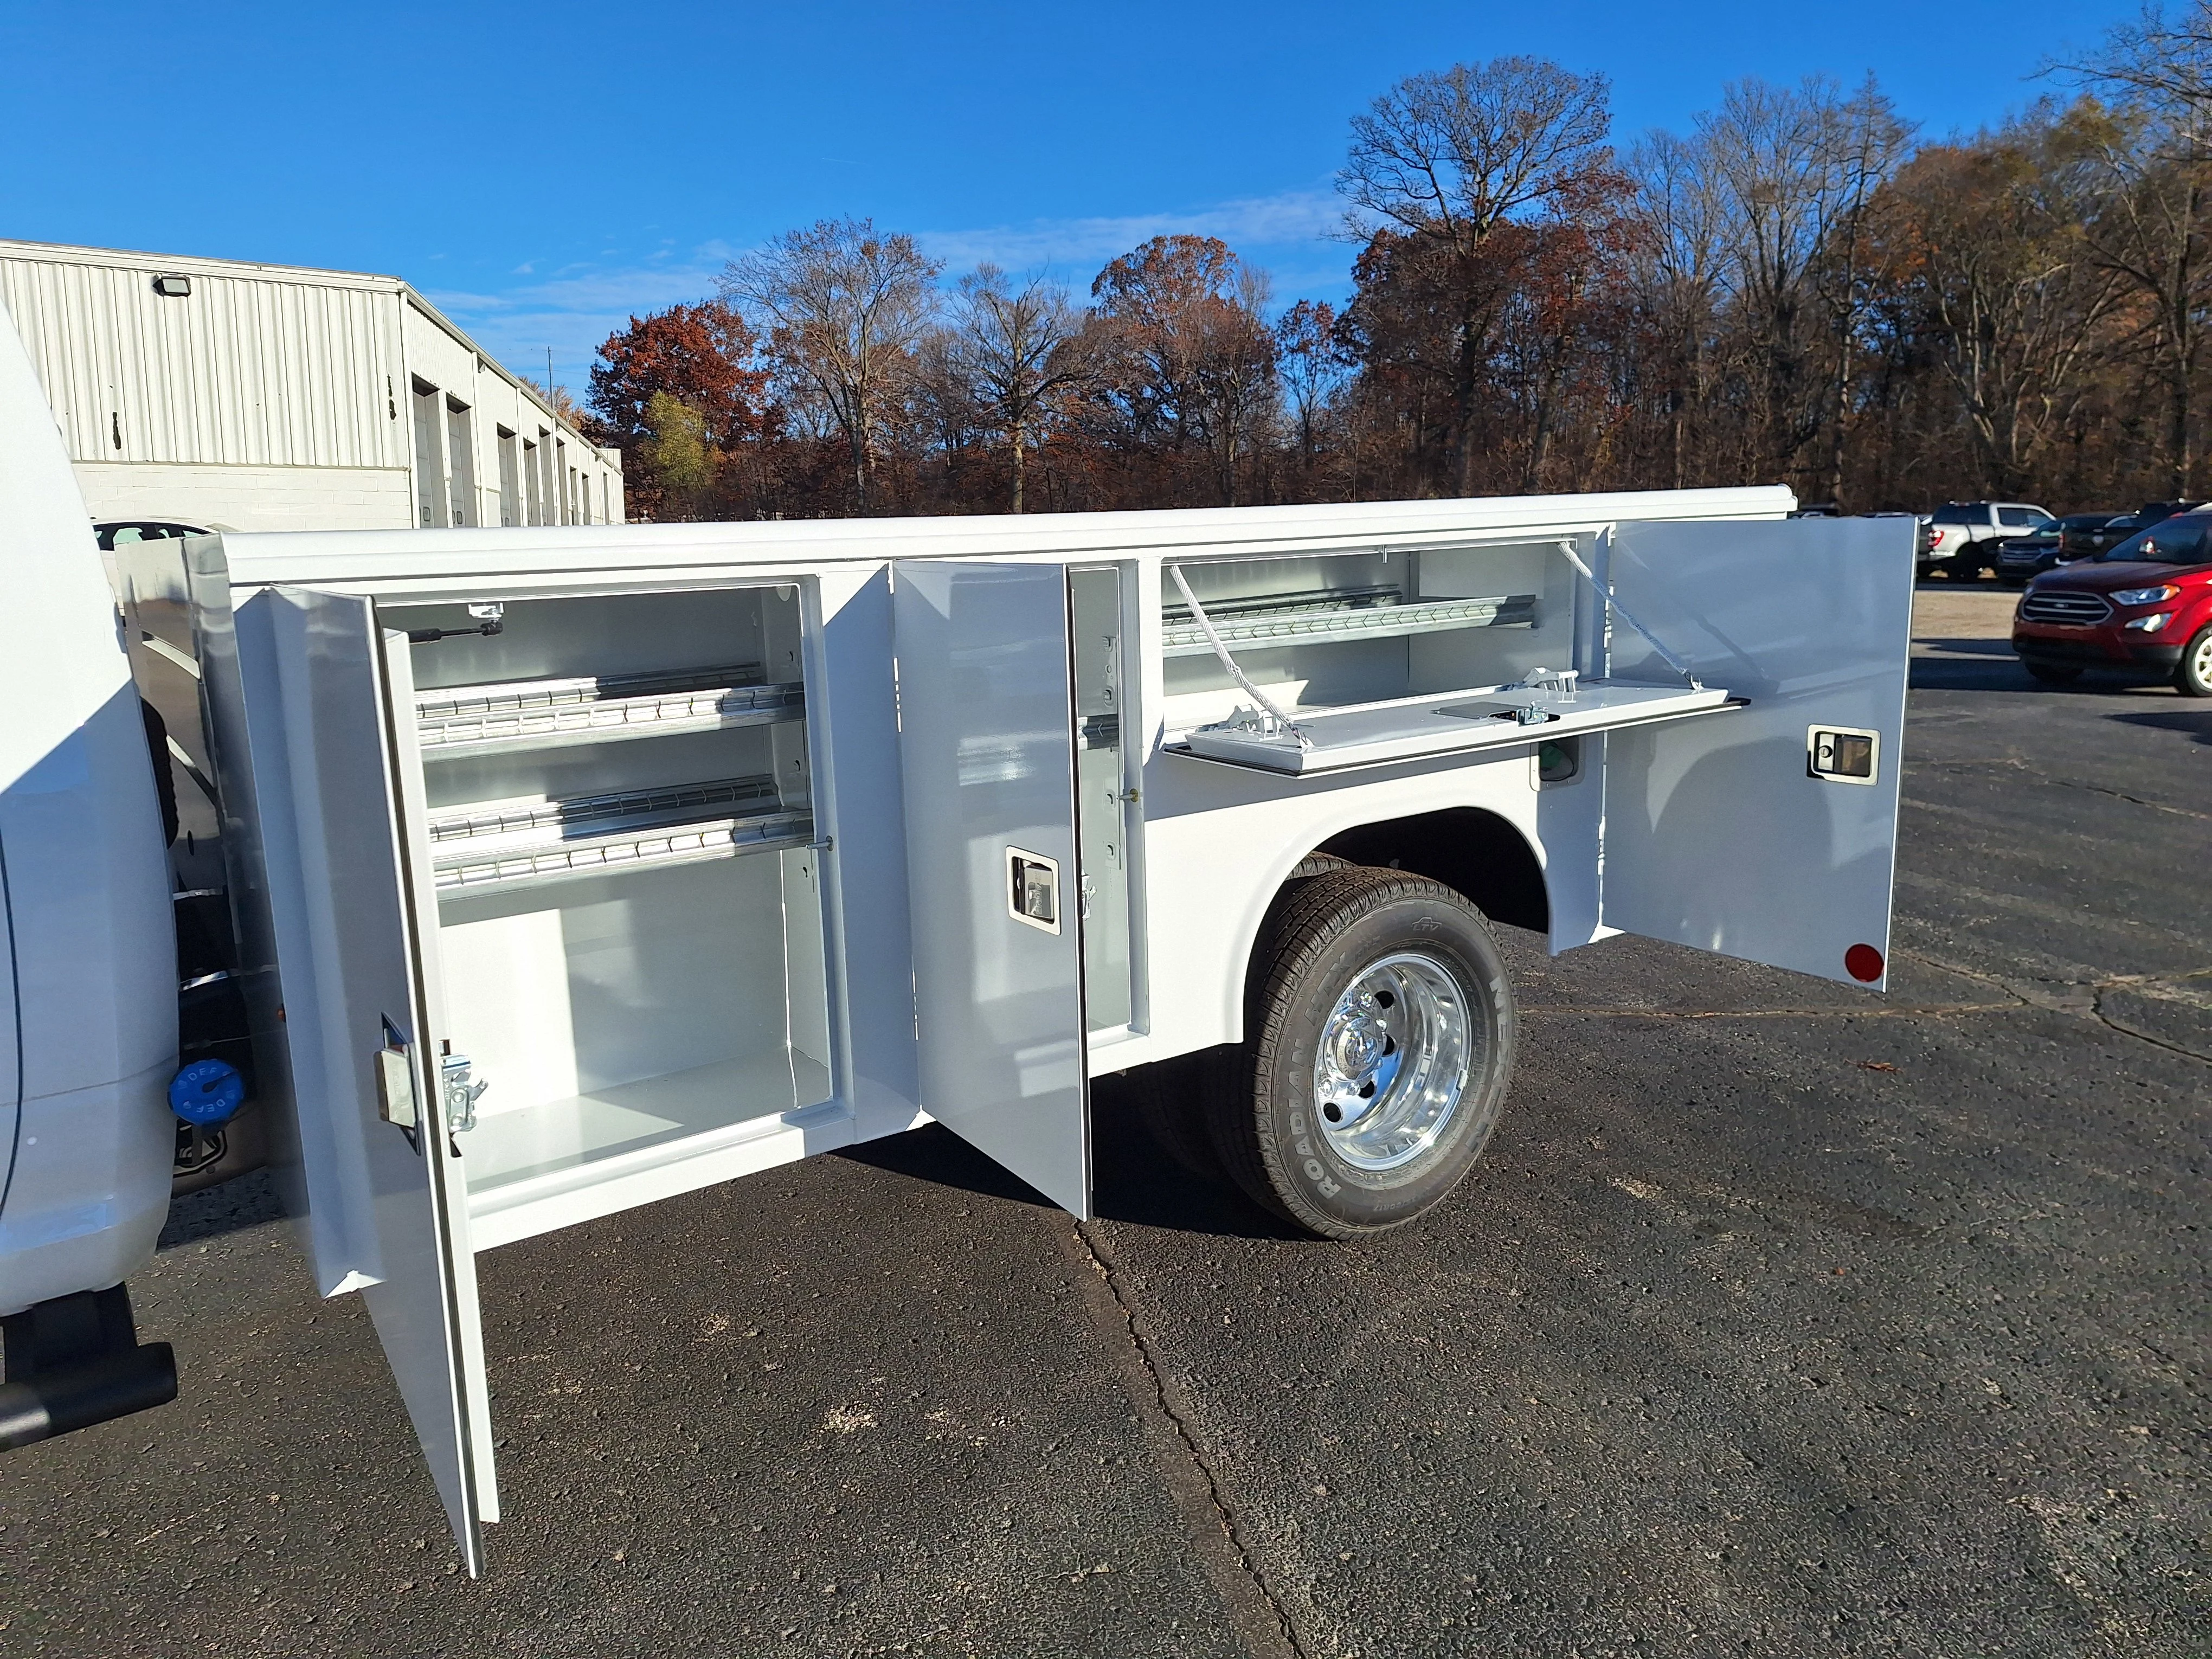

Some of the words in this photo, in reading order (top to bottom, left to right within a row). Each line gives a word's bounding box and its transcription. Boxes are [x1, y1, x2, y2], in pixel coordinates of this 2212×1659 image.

[1304, 951, 1351, 1026] HTX
[188, 1067, 217, 1081] DEF
[1465, 976, 1509, 1153] NEXEN
[196, 1098, 226, 1113] DEF
[1288, 1038, 1342, 1199] ROADIAN
